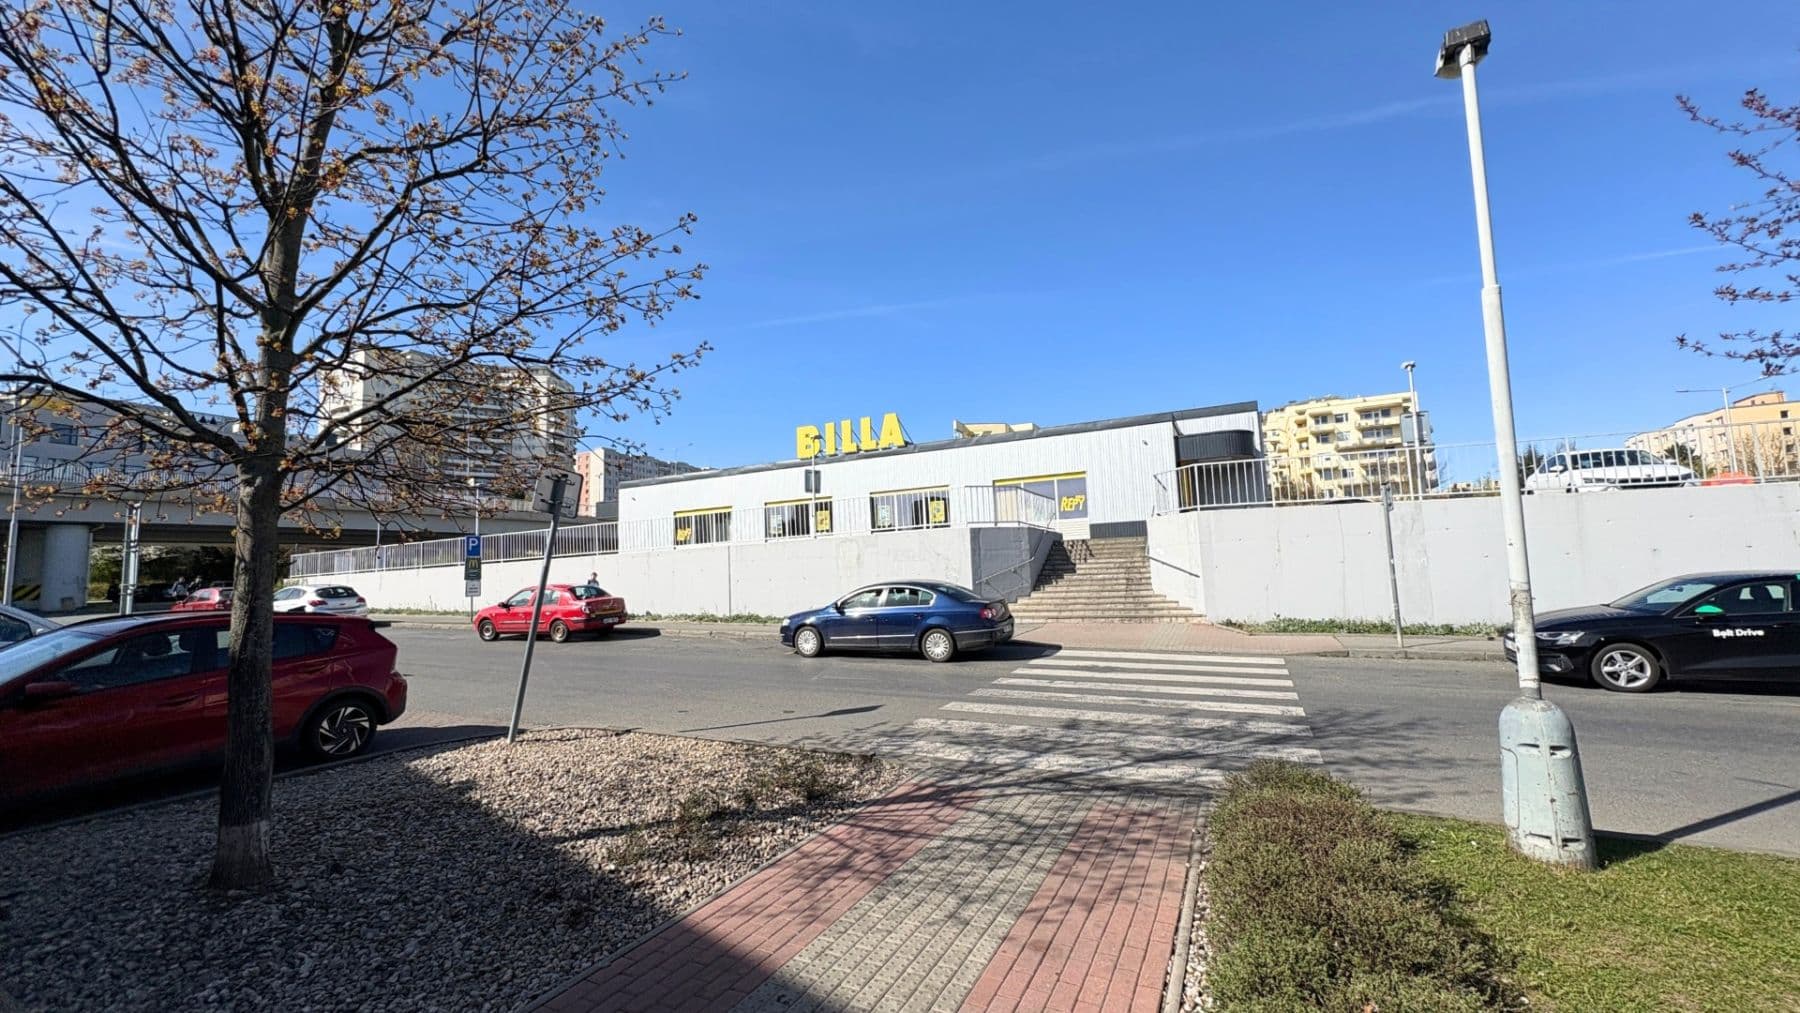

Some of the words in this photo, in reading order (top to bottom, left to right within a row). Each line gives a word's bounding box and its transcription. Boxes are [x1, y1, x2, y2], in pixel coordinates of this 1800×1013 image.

[796, 412, 906, 459] BILLA
[469, 537, 479, 551] P
[1712, 628, 1734, 639] Bolt
[1735, 628, 1765, 637] Drive
